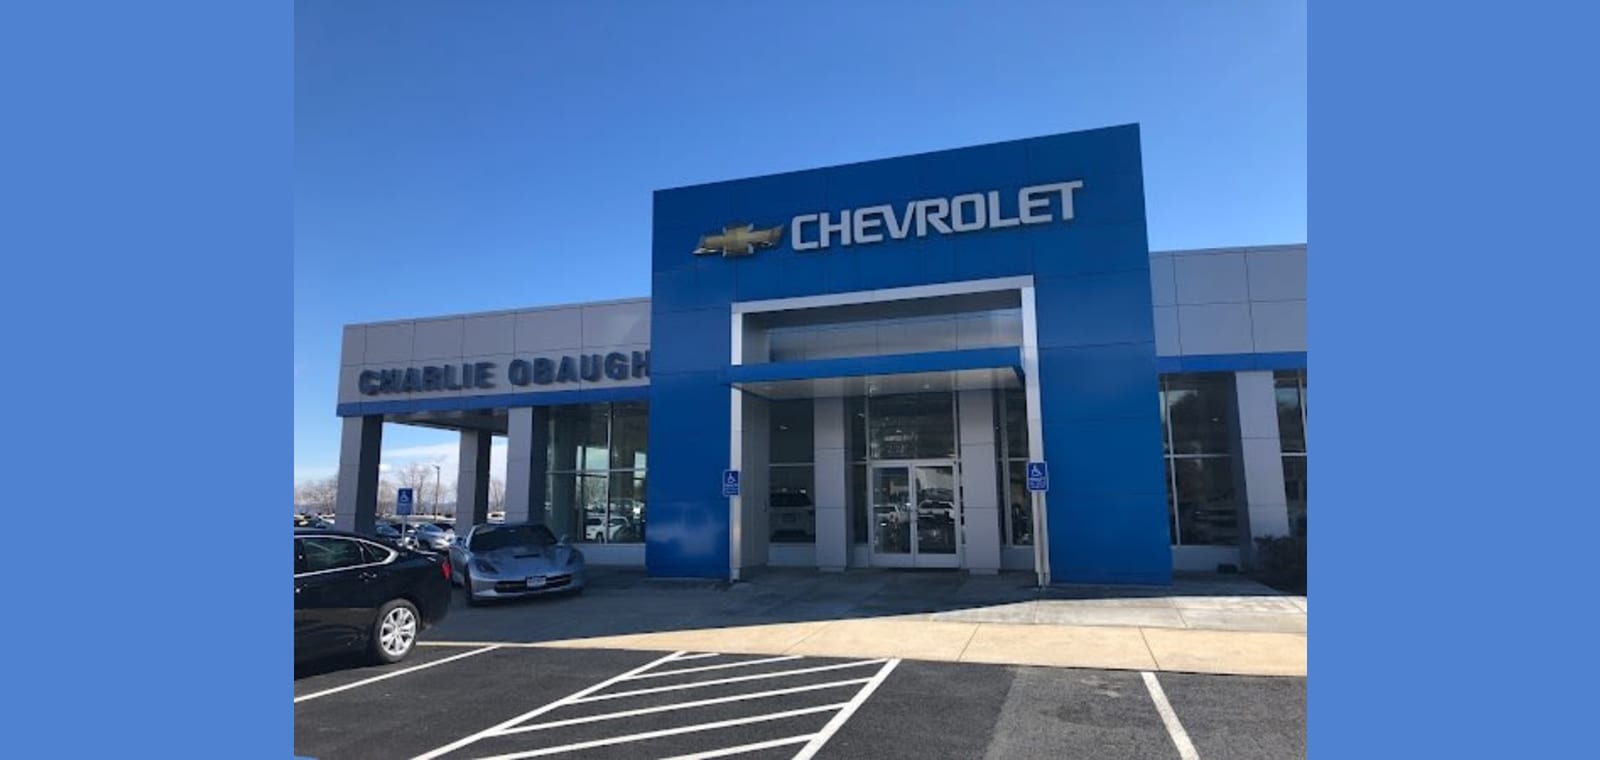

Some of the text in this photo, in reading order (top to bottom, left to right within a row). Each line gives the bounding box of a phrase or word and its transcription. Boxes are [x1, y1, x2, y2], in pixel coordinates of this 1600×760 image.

[791, 180, 1083, 251] CHEVROLET
[358, 350, 651, 396] CHARLIE OBAUGH
